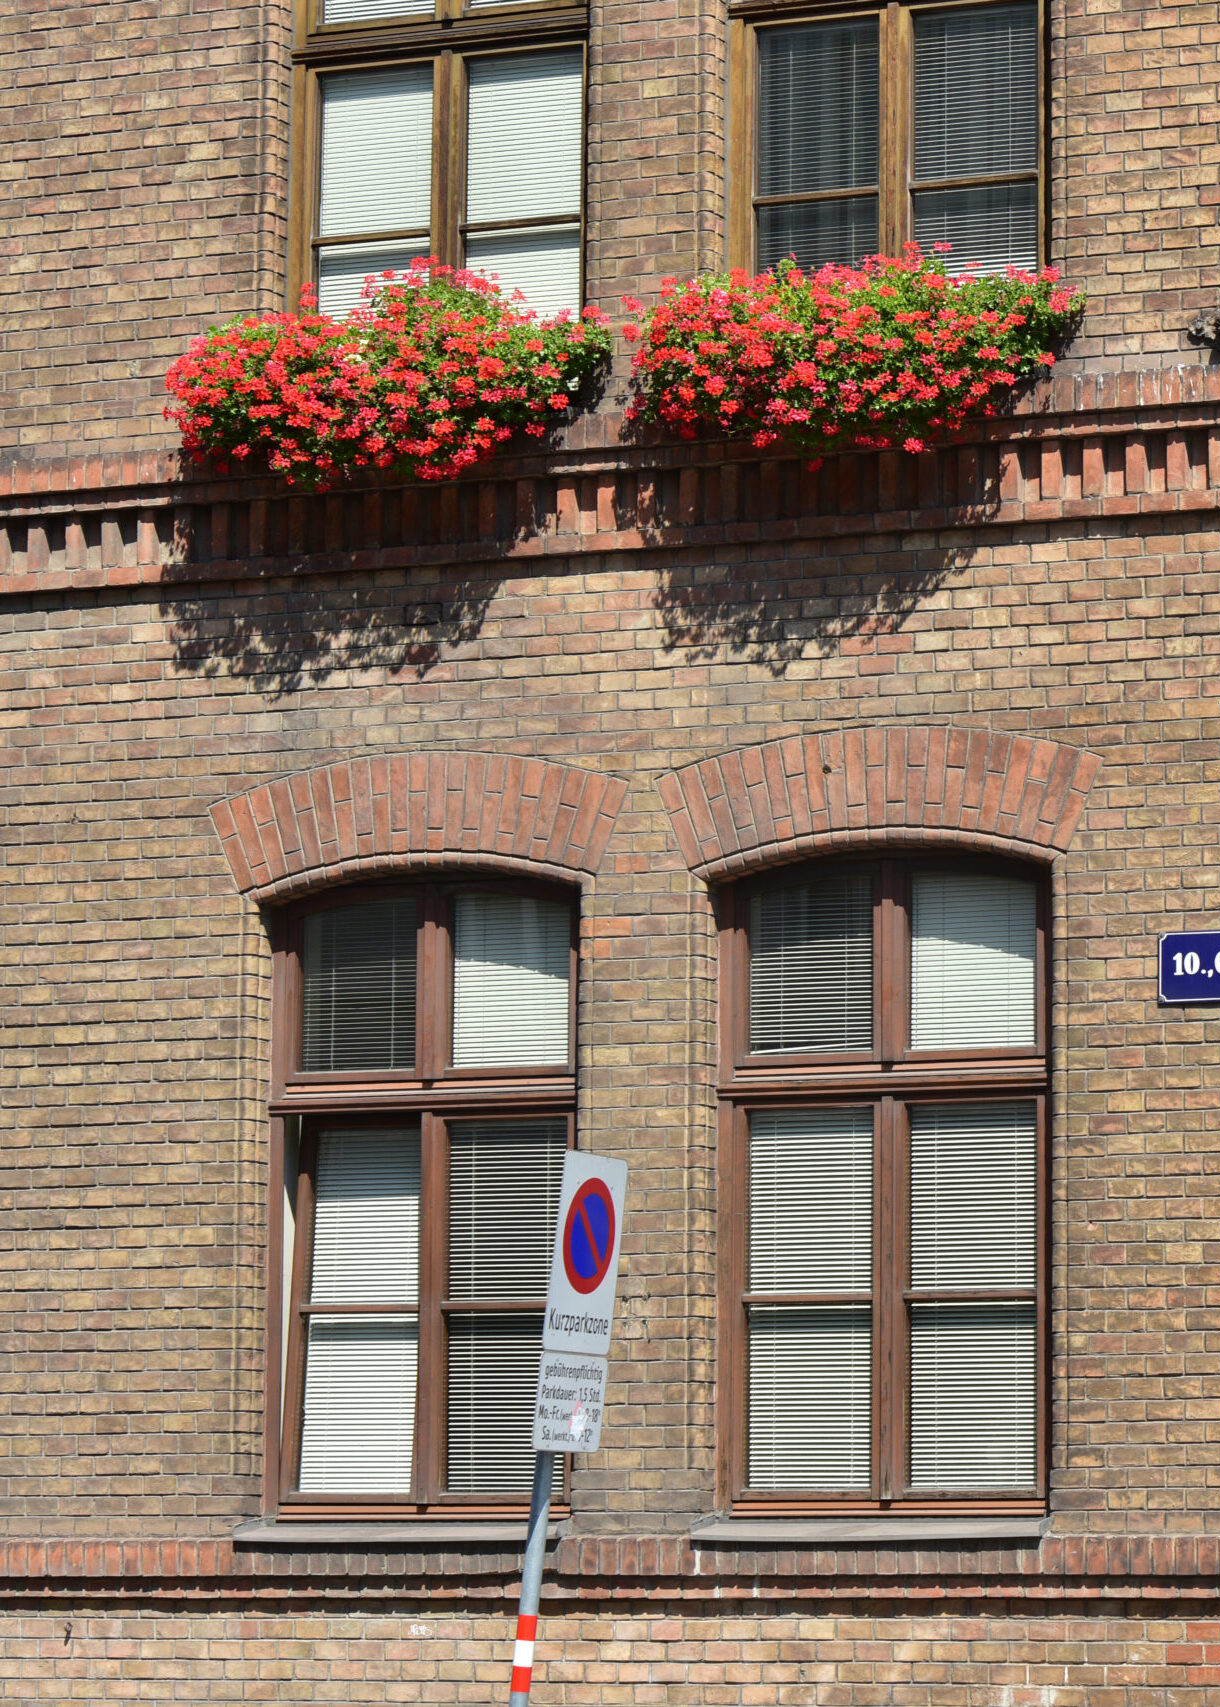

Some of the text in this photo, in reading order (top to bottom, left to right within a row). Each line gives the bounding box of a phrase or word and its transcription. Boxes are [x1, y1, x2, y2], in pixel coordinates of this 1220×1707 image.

[548, 1307, 609, 1337] Kurzparkzone
[544, 1362, 603, 1384] gebührenpflichtig
[541, 1384, 577, 1401] Parkdauer:
[589, 1387, 602, 1402] Std.
[541, 1425, 552, 1440] Sa.
